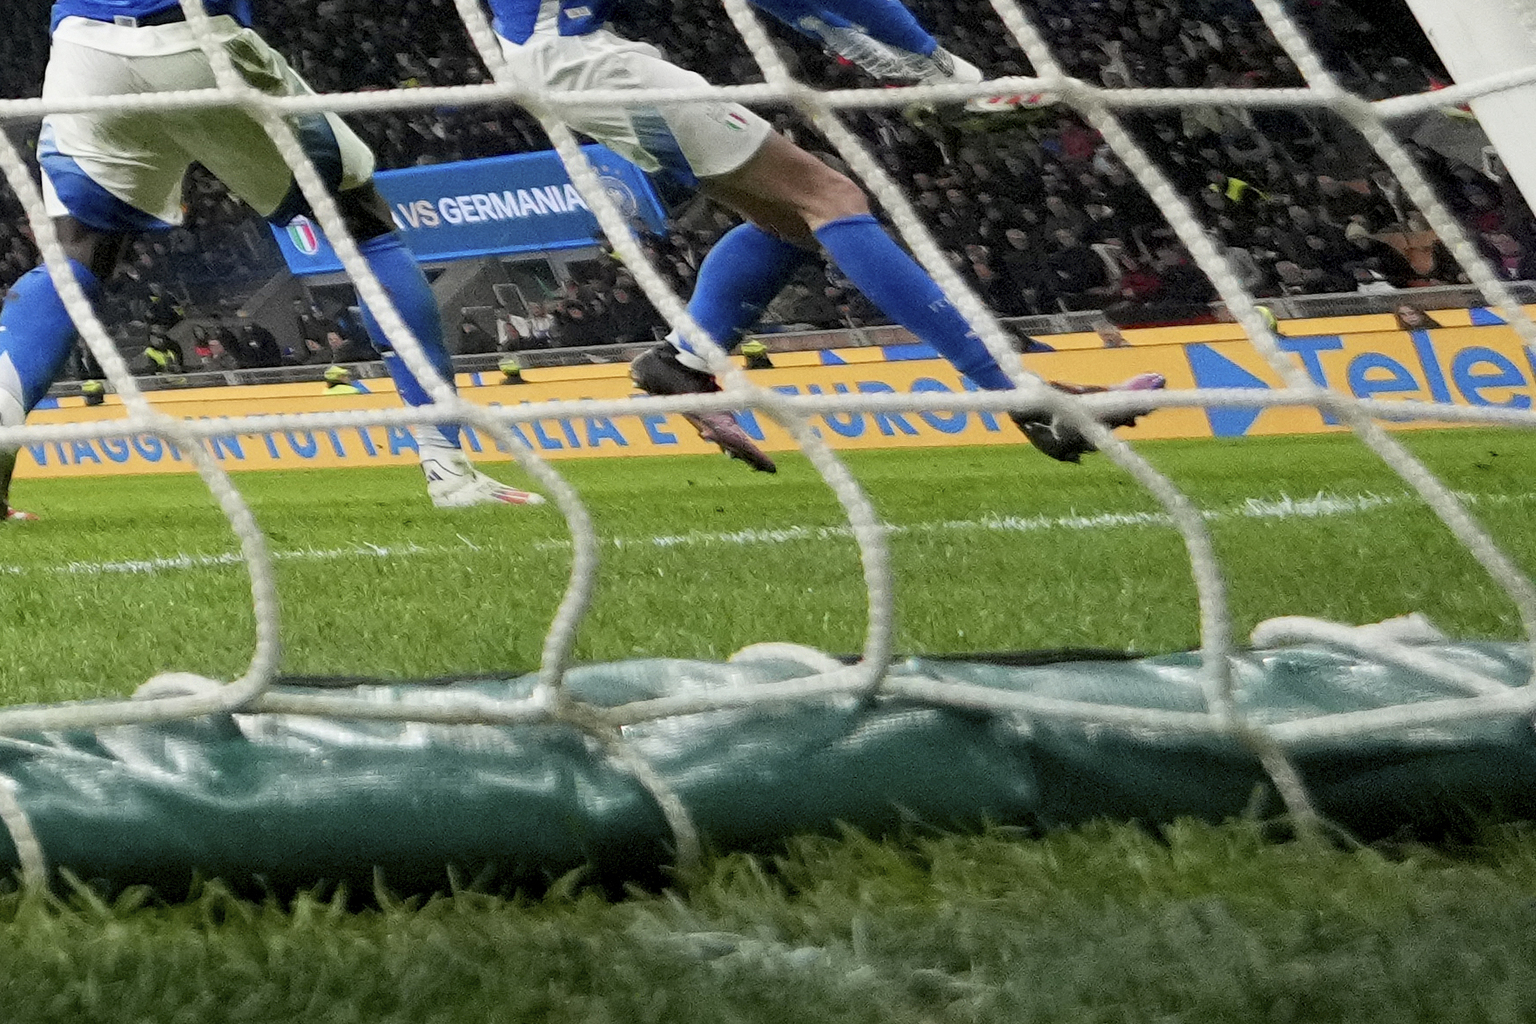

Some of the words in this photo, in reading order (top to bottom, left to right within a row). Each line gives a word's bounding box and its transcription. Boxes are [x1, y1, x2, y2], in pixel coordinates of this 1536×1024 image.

[397, 200, 440, 230] VS
[438, 182, 589, 225] GERMANIA
[1272, 329, 1536, 426] Tele
